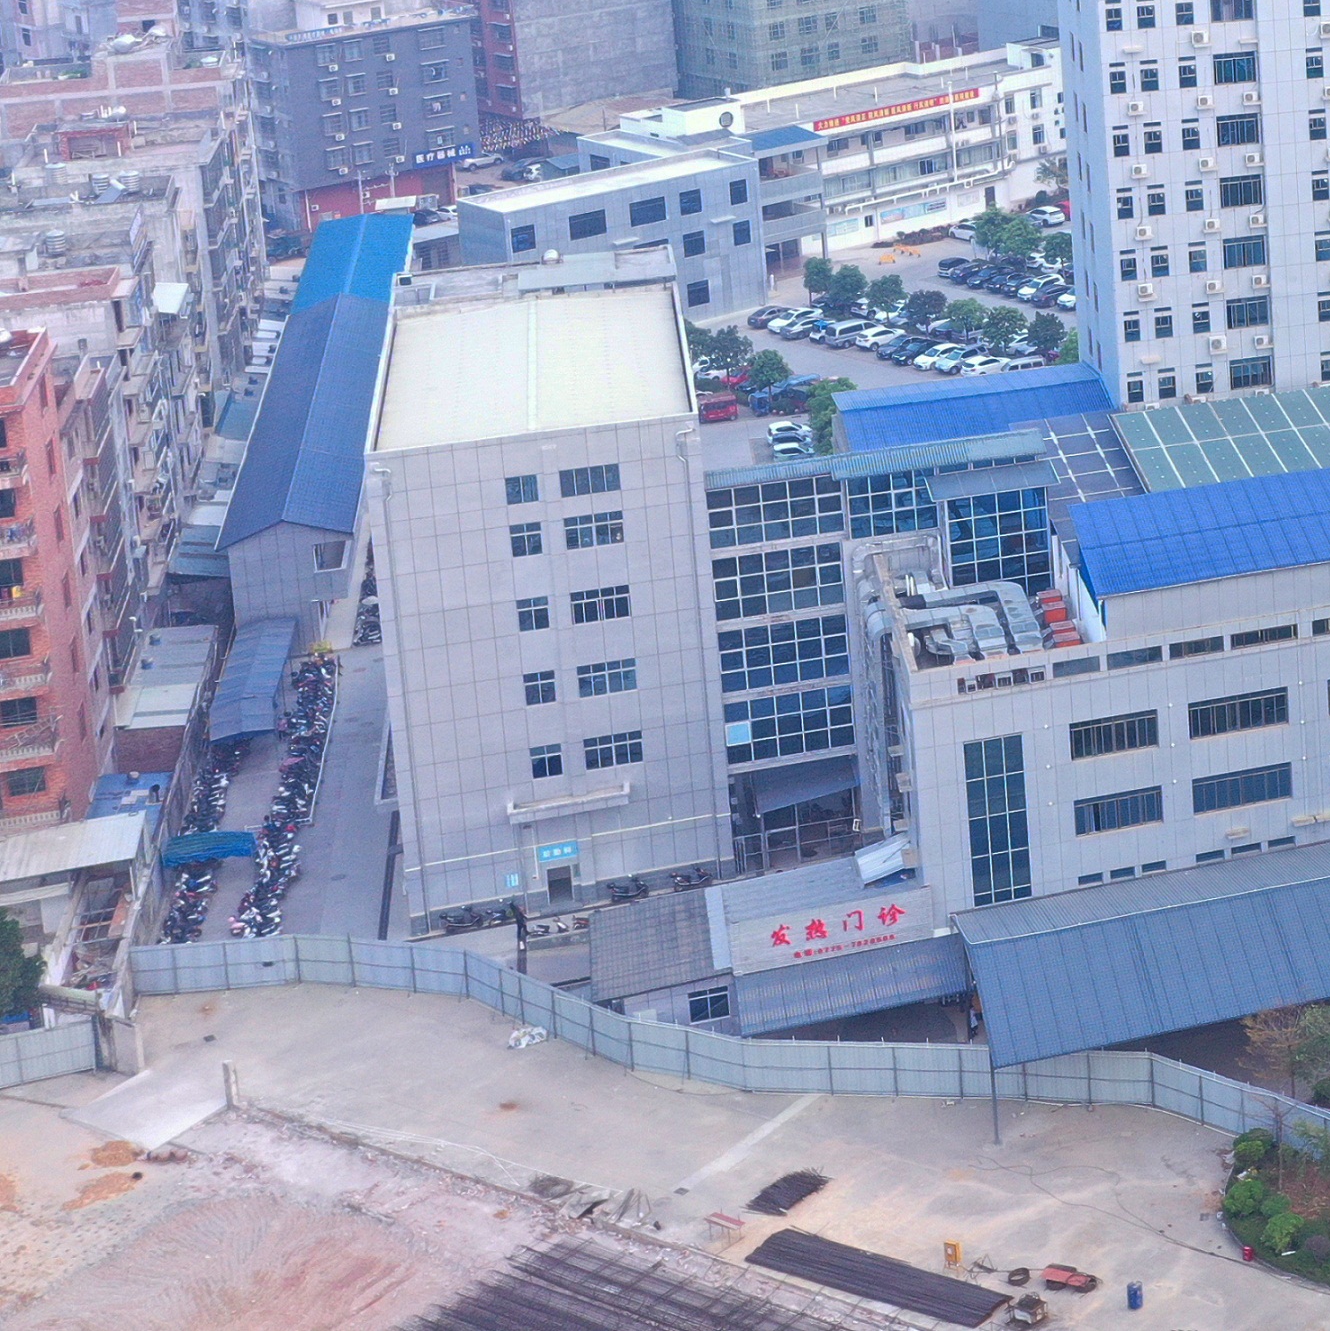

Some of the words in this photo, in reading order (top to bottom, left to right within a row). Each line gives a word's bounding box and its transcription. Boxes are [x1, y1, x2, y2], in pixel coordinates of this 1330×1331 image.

[415, 148, 456, 164] 医疗器械
[771, 904, 906, 947] 发热门诊
